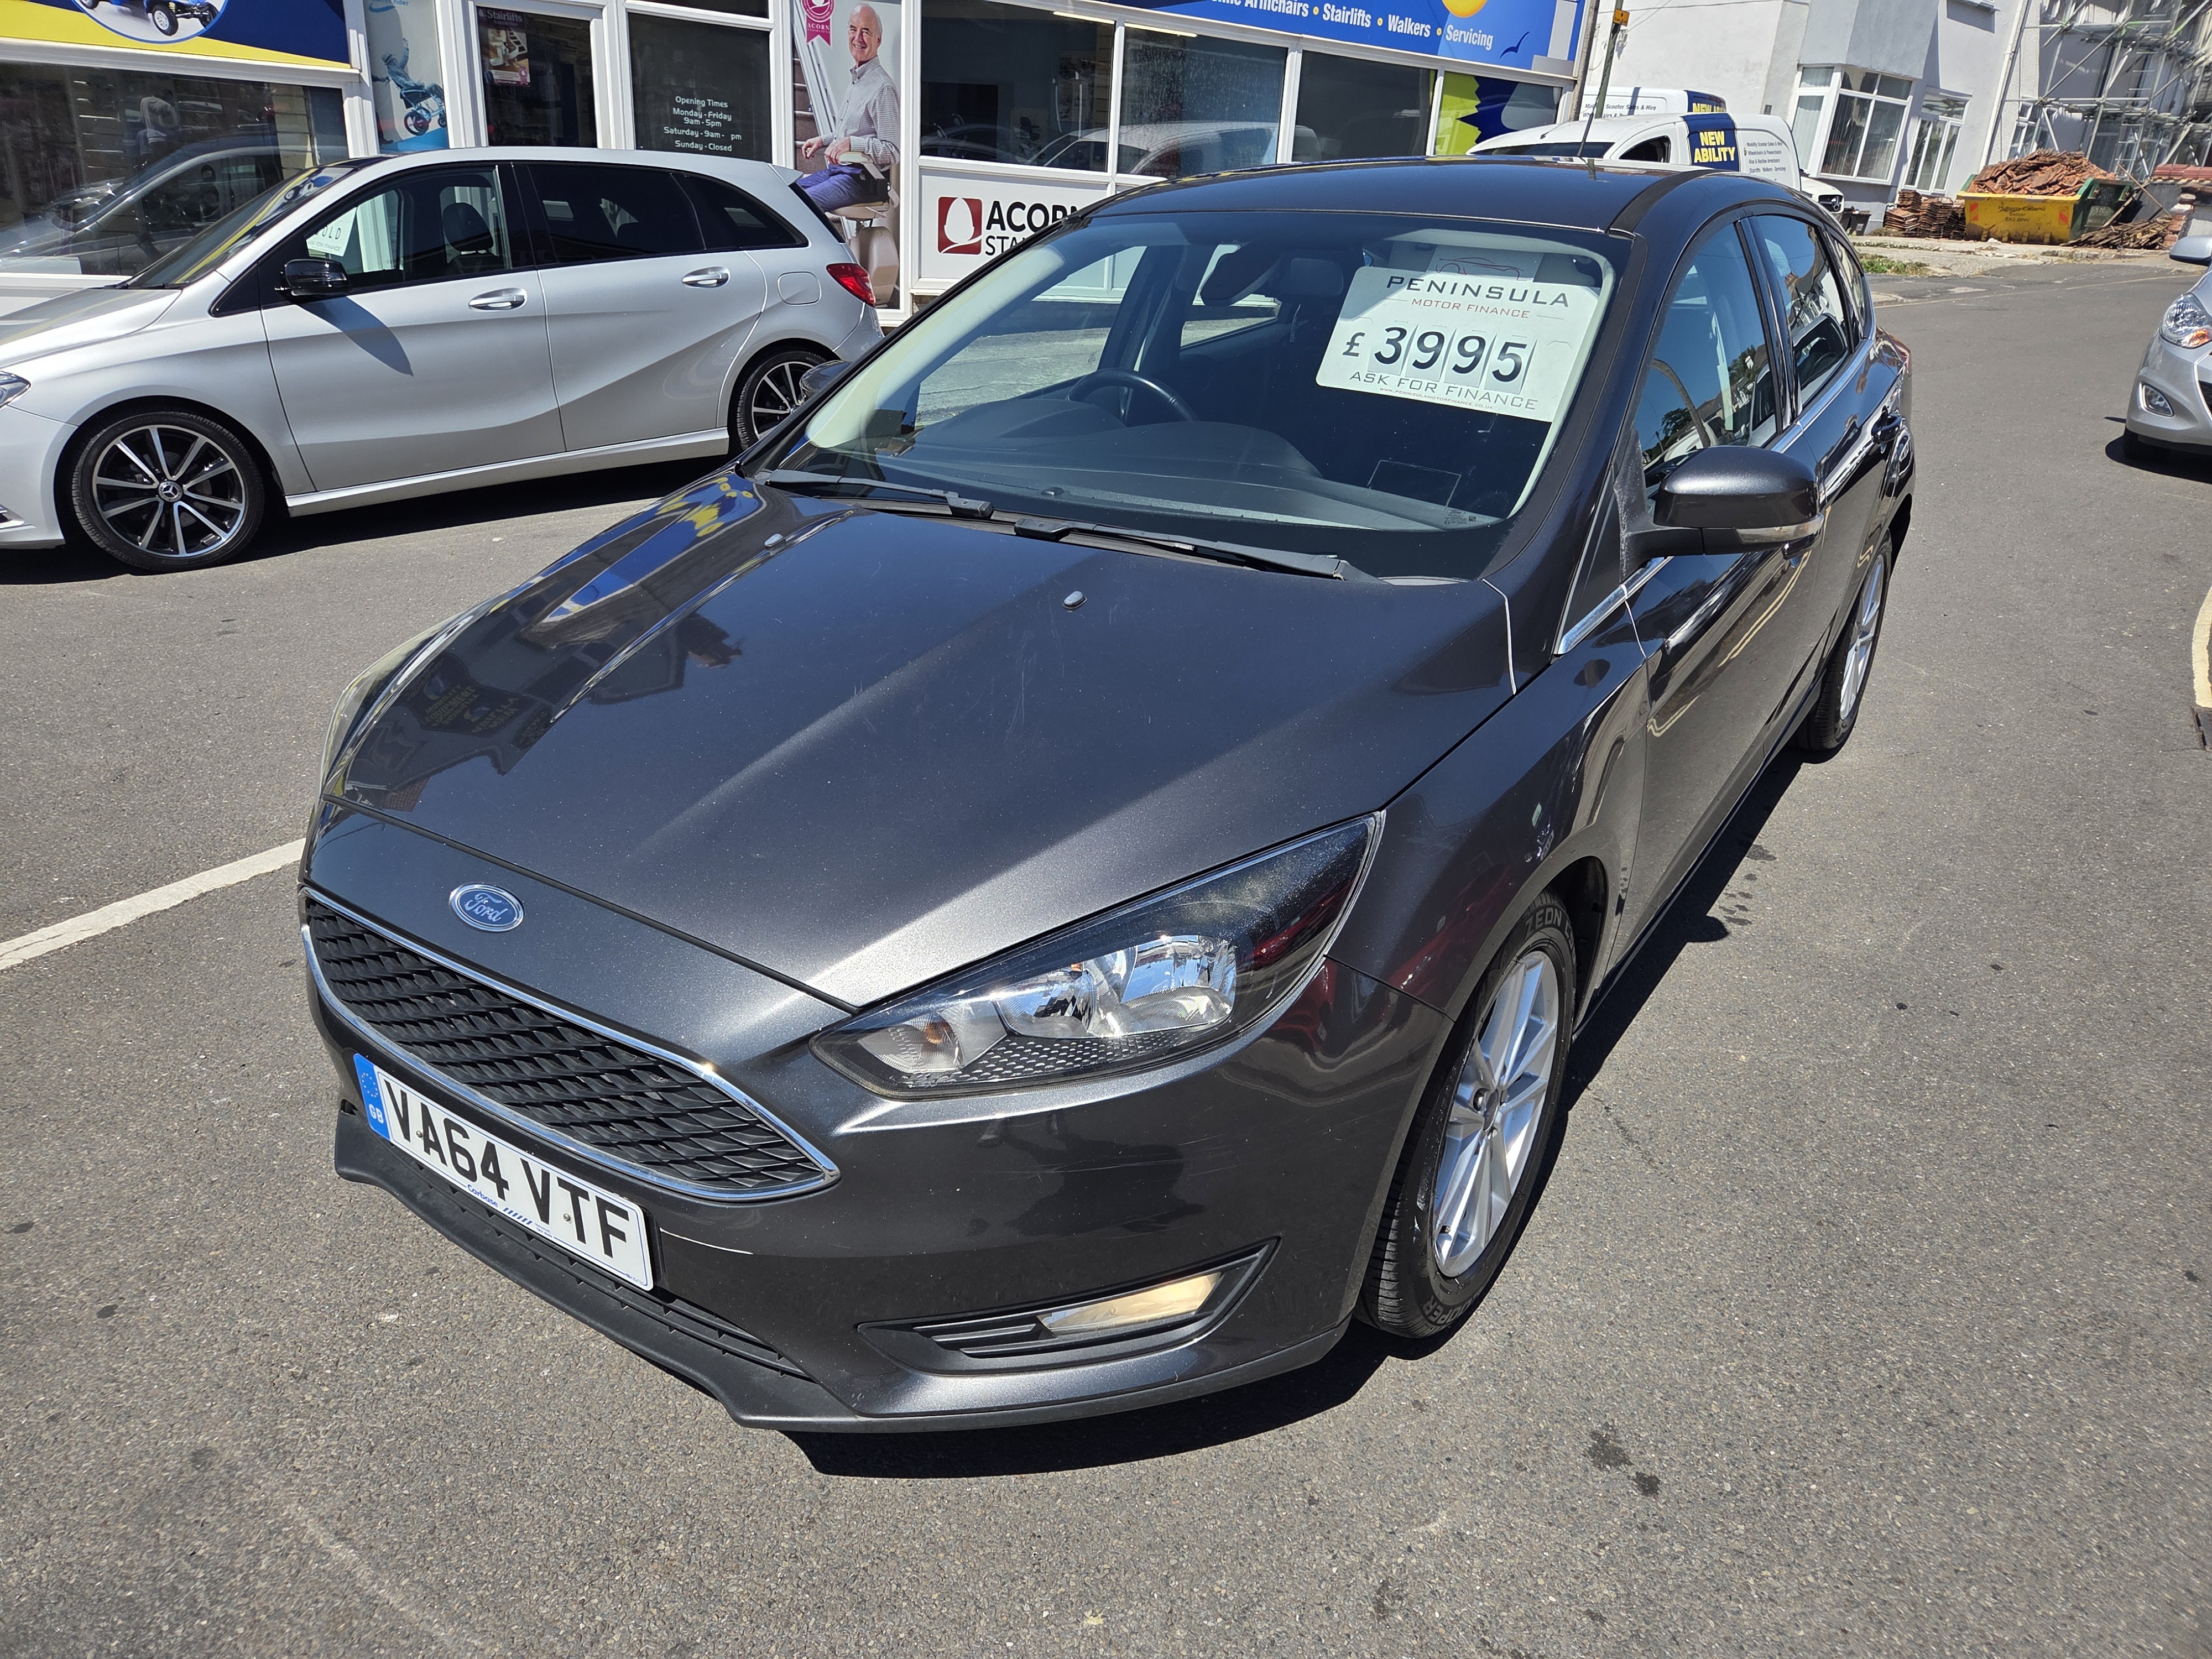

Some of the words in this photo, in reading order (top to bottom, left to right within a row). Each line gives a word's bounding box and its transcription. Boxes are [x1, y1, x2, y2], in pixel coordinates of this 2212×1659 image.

[487, 10, 523, 22] Stairlifts
[1322, 3, 1371, 28] Stairlifts
[1388, 14, 1431, 38] Walkers
[1446, 24, 1493, 50] Servicing
[675, 96, 706, 107] Opening
[707, 99, 728, 108] Times
[673, 108, 702, 118] Monday
[708, 111, 732, 121] Friday
[705, 119, 722, 128] 5pm
[664, 127, 699, 138] Saturday
[704, 130, 721, 138] 9am
[1699, 131, 1724, 146] NEW
[675, 140, 703, 150] Sunday
[708, 143, 732, 152] Closed
[1694, 147, 1735, 163] ABILITY
[986, 201, 1078, 234] ACOR
[321, 226, 341, 239] OLD
[1386, 275, 1569, 307] PENINSULA
[1412, 299, 1461, 311] MOTOR
[1467, 304, 1531, 319] FINANCE
[1342, 332, 1366, 357] £
[1374, 326, 1527, 382] 3995
[1349, 372, 1390, 385] ASK
[1397, 378, 1437, 393] FOR
[1445, 386, 1538, 410] FINANCE
[465, 892, 508, 922] Ford
[368, 1104, 384, 1124] GB
[384, 1079, 509, 1202] VA64
[520, 1158, 629, 1259] VTF
[467, 1185, 498, 1208] Carbase
